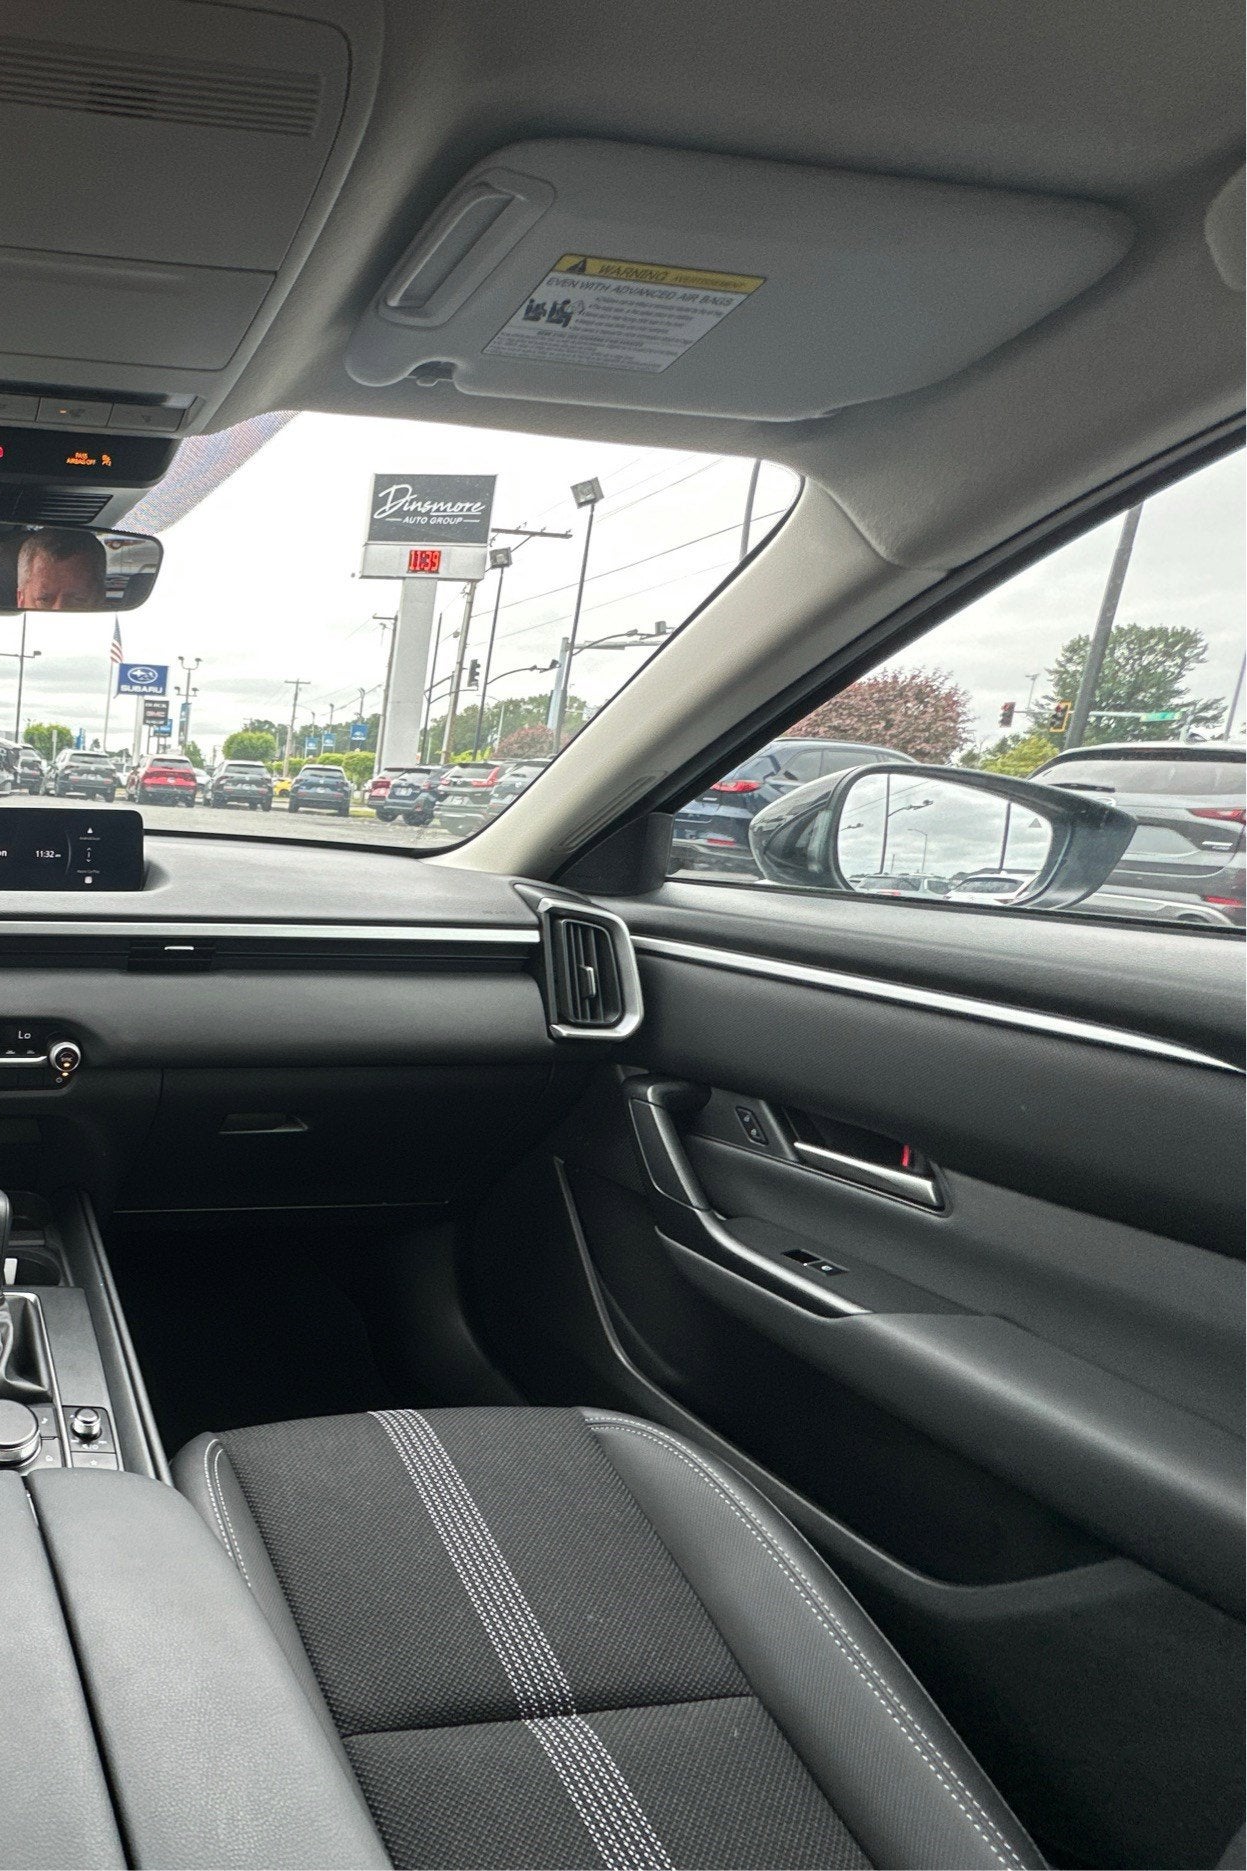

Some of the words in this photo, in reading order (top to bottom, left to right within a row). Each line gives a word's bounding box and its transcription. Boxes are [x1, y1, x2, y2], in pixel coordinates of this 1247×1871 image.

[599, 264, 670, 281] WARNING
[546, 277, 577, 289] EVEN
[579, 280, 609, 292] WITH
[612, 284, 677, 299] ADVANCED
[373, 484, 486, 519] Dinsmore
[402, 516, 428, 524] AUTO
[429, 516, 464, 525] GROUP
[409, 550, 440, 571] 11:39
[120, 684, 163, 693] SUBARU
[36, 850, 55, 858] 11:32
